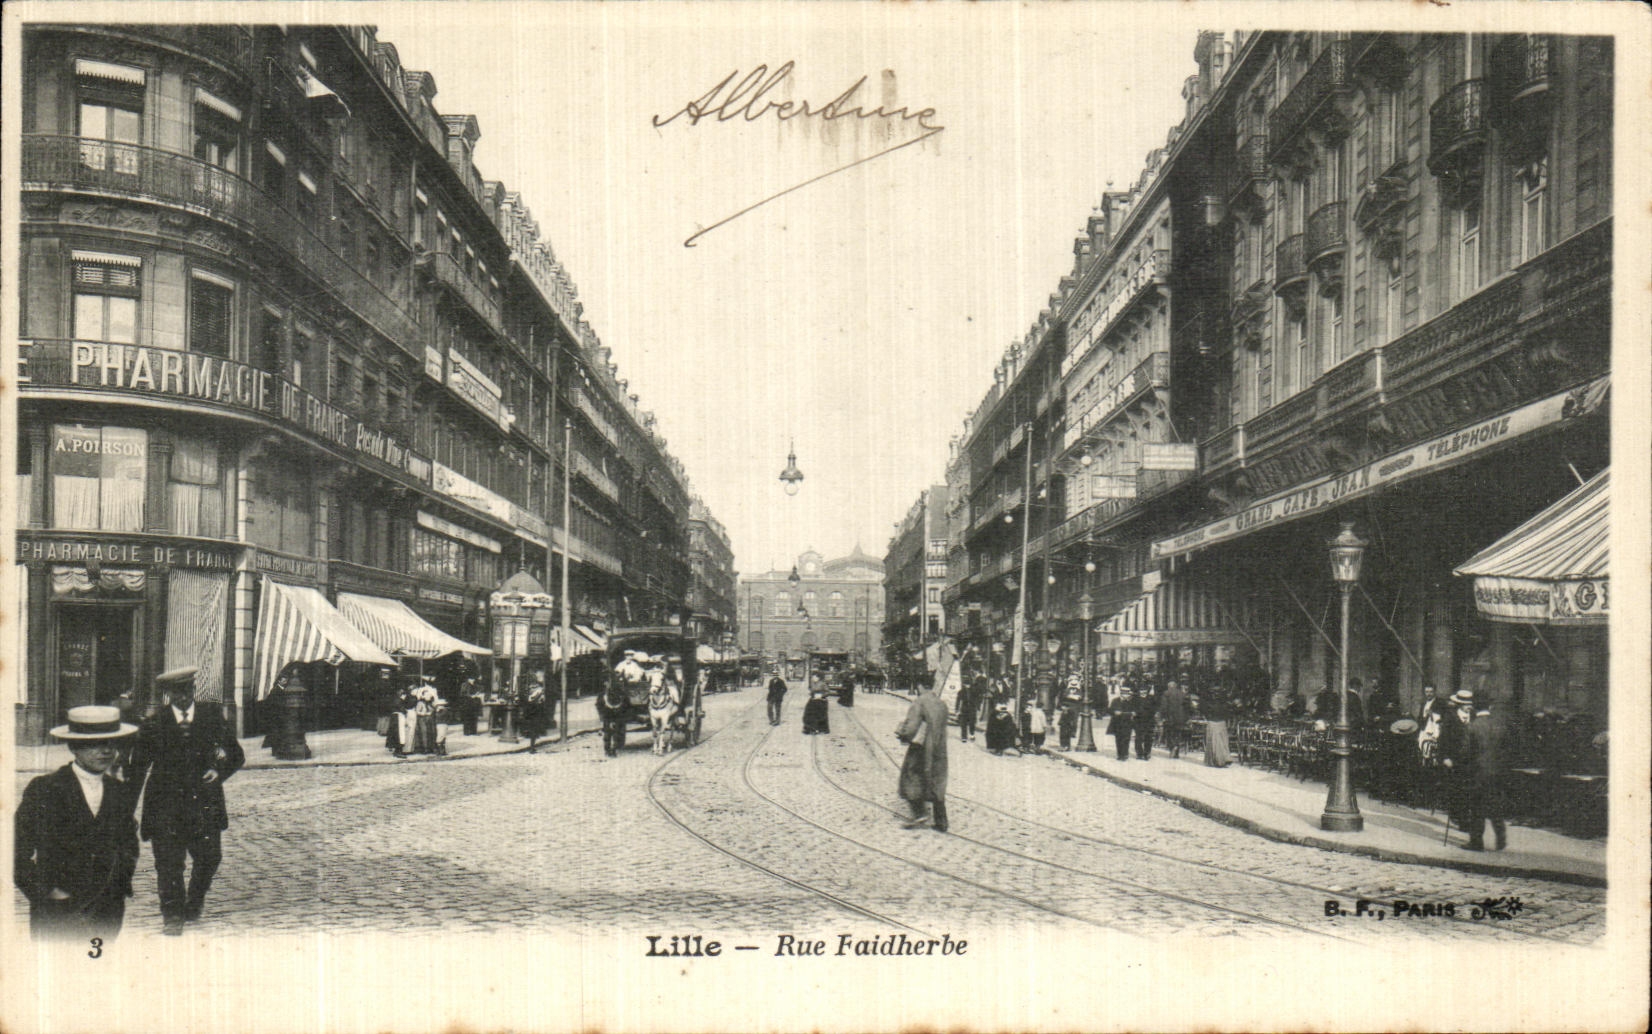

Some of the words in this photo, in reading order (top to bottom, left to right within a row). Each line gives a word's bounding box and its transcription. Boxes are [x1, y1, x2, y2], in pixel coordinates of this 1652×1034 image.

[71, 341, 272, 411] PHARMACIE
[282, 380, 299, 422] DE
[306, 394, 349, 447] FRANCE
[1235, 503, 1272, 531] GRAND
[1331, 470, 1369, 500] JEAN
[20, 541, 141, 563] PHARMACIE
[153, 546, 176, 564] DE
[186, 549, 233, 569] FRANCE
